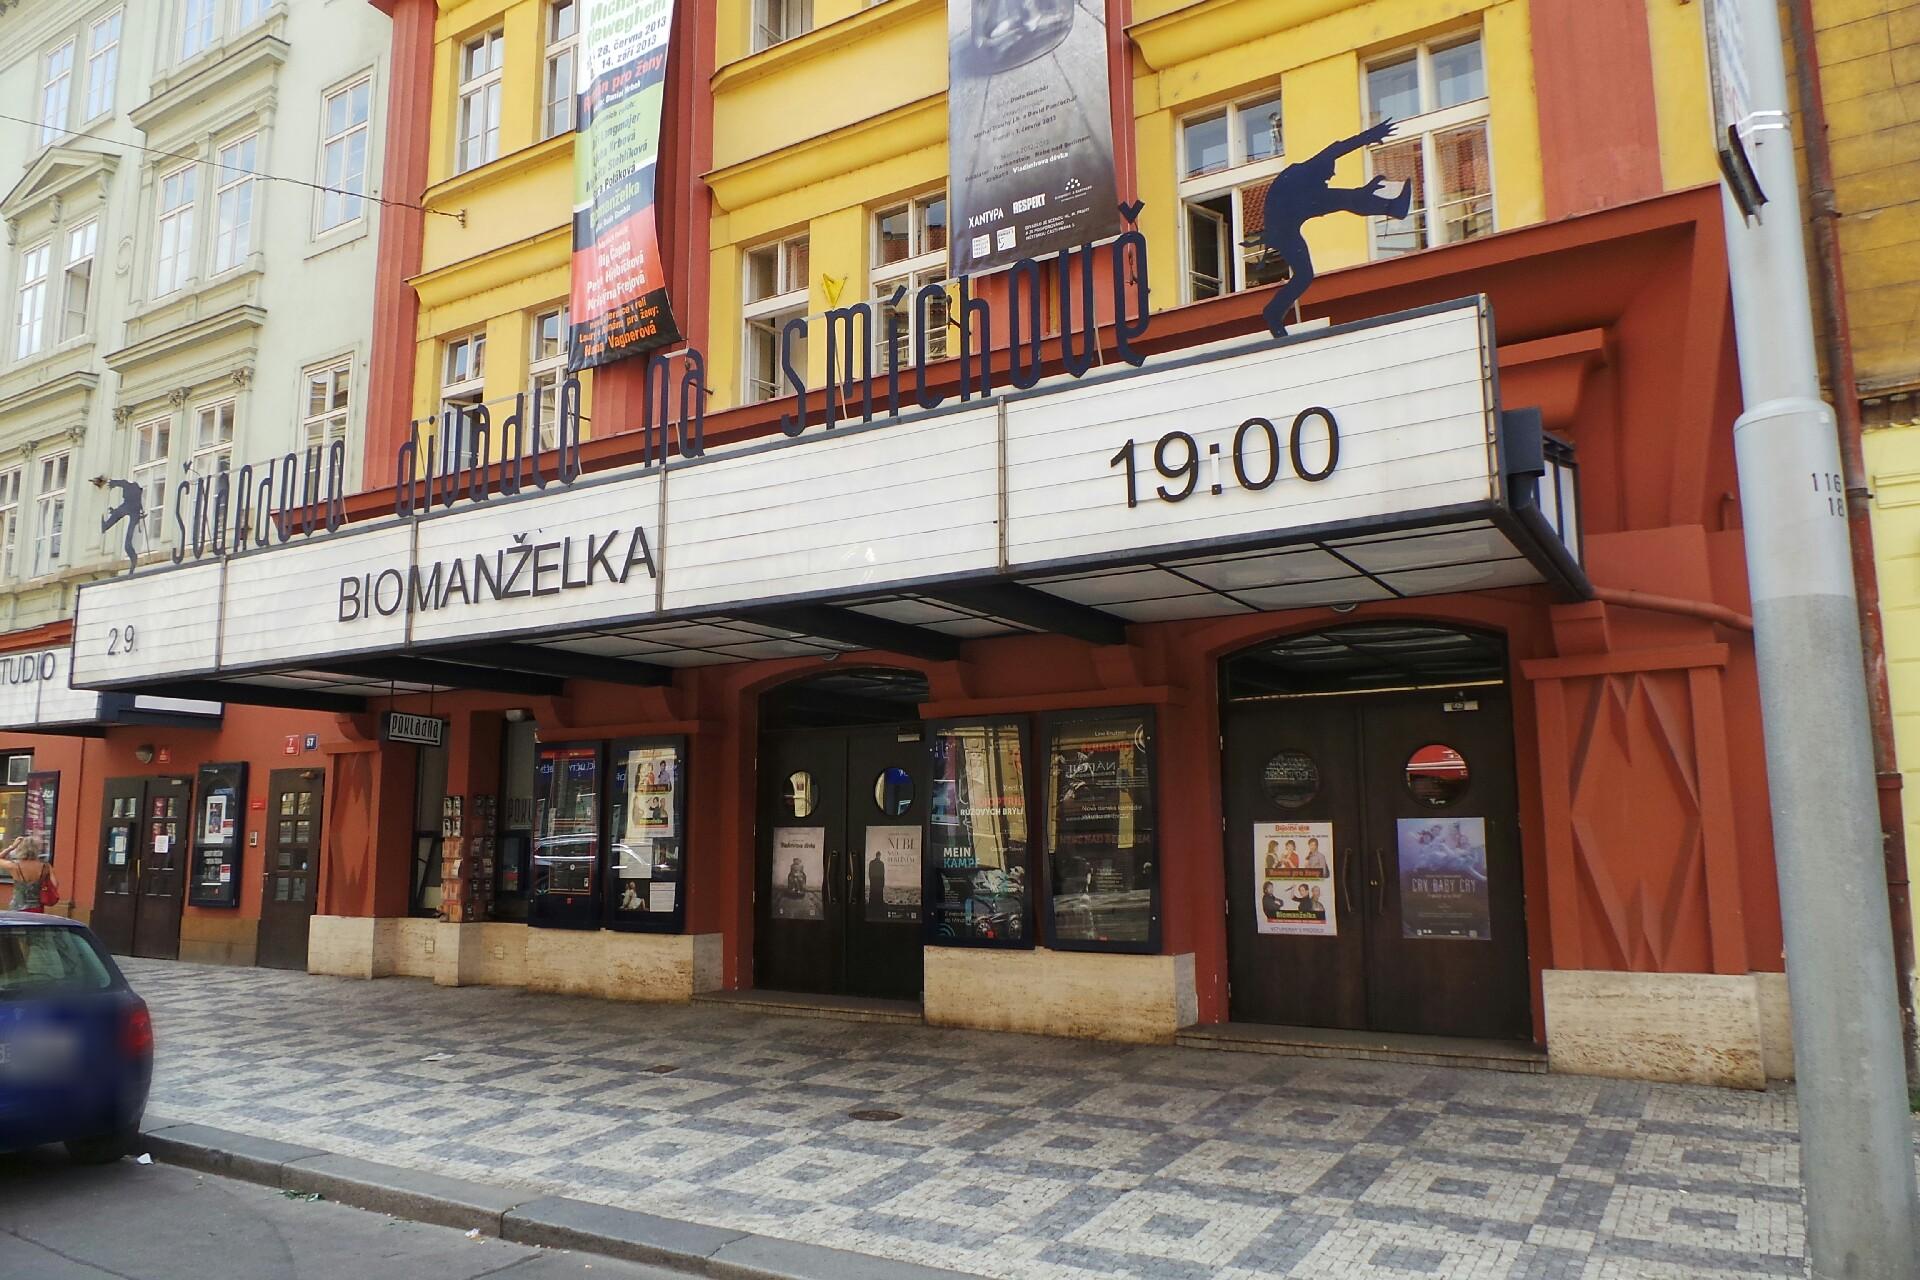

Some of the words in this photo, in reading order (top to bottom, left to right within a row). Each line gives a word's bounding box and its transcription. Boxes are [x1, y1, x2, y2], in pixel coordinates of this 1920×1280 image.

[645, 15, 667, 36] 2013
[636, 34, 656, 53] 2013
[612, 69, 632, 92] pro
[635, 53, 664, 77] ženy
[1012, 193, 1046, 215] RESPEKT
[968, 206, 1005, 230] XANTYPA
[608, 319, 656, 349] Vagnerová
[1110, 406, 1340, 509] 19:00
[943, 847, 971, 858] MEIN
